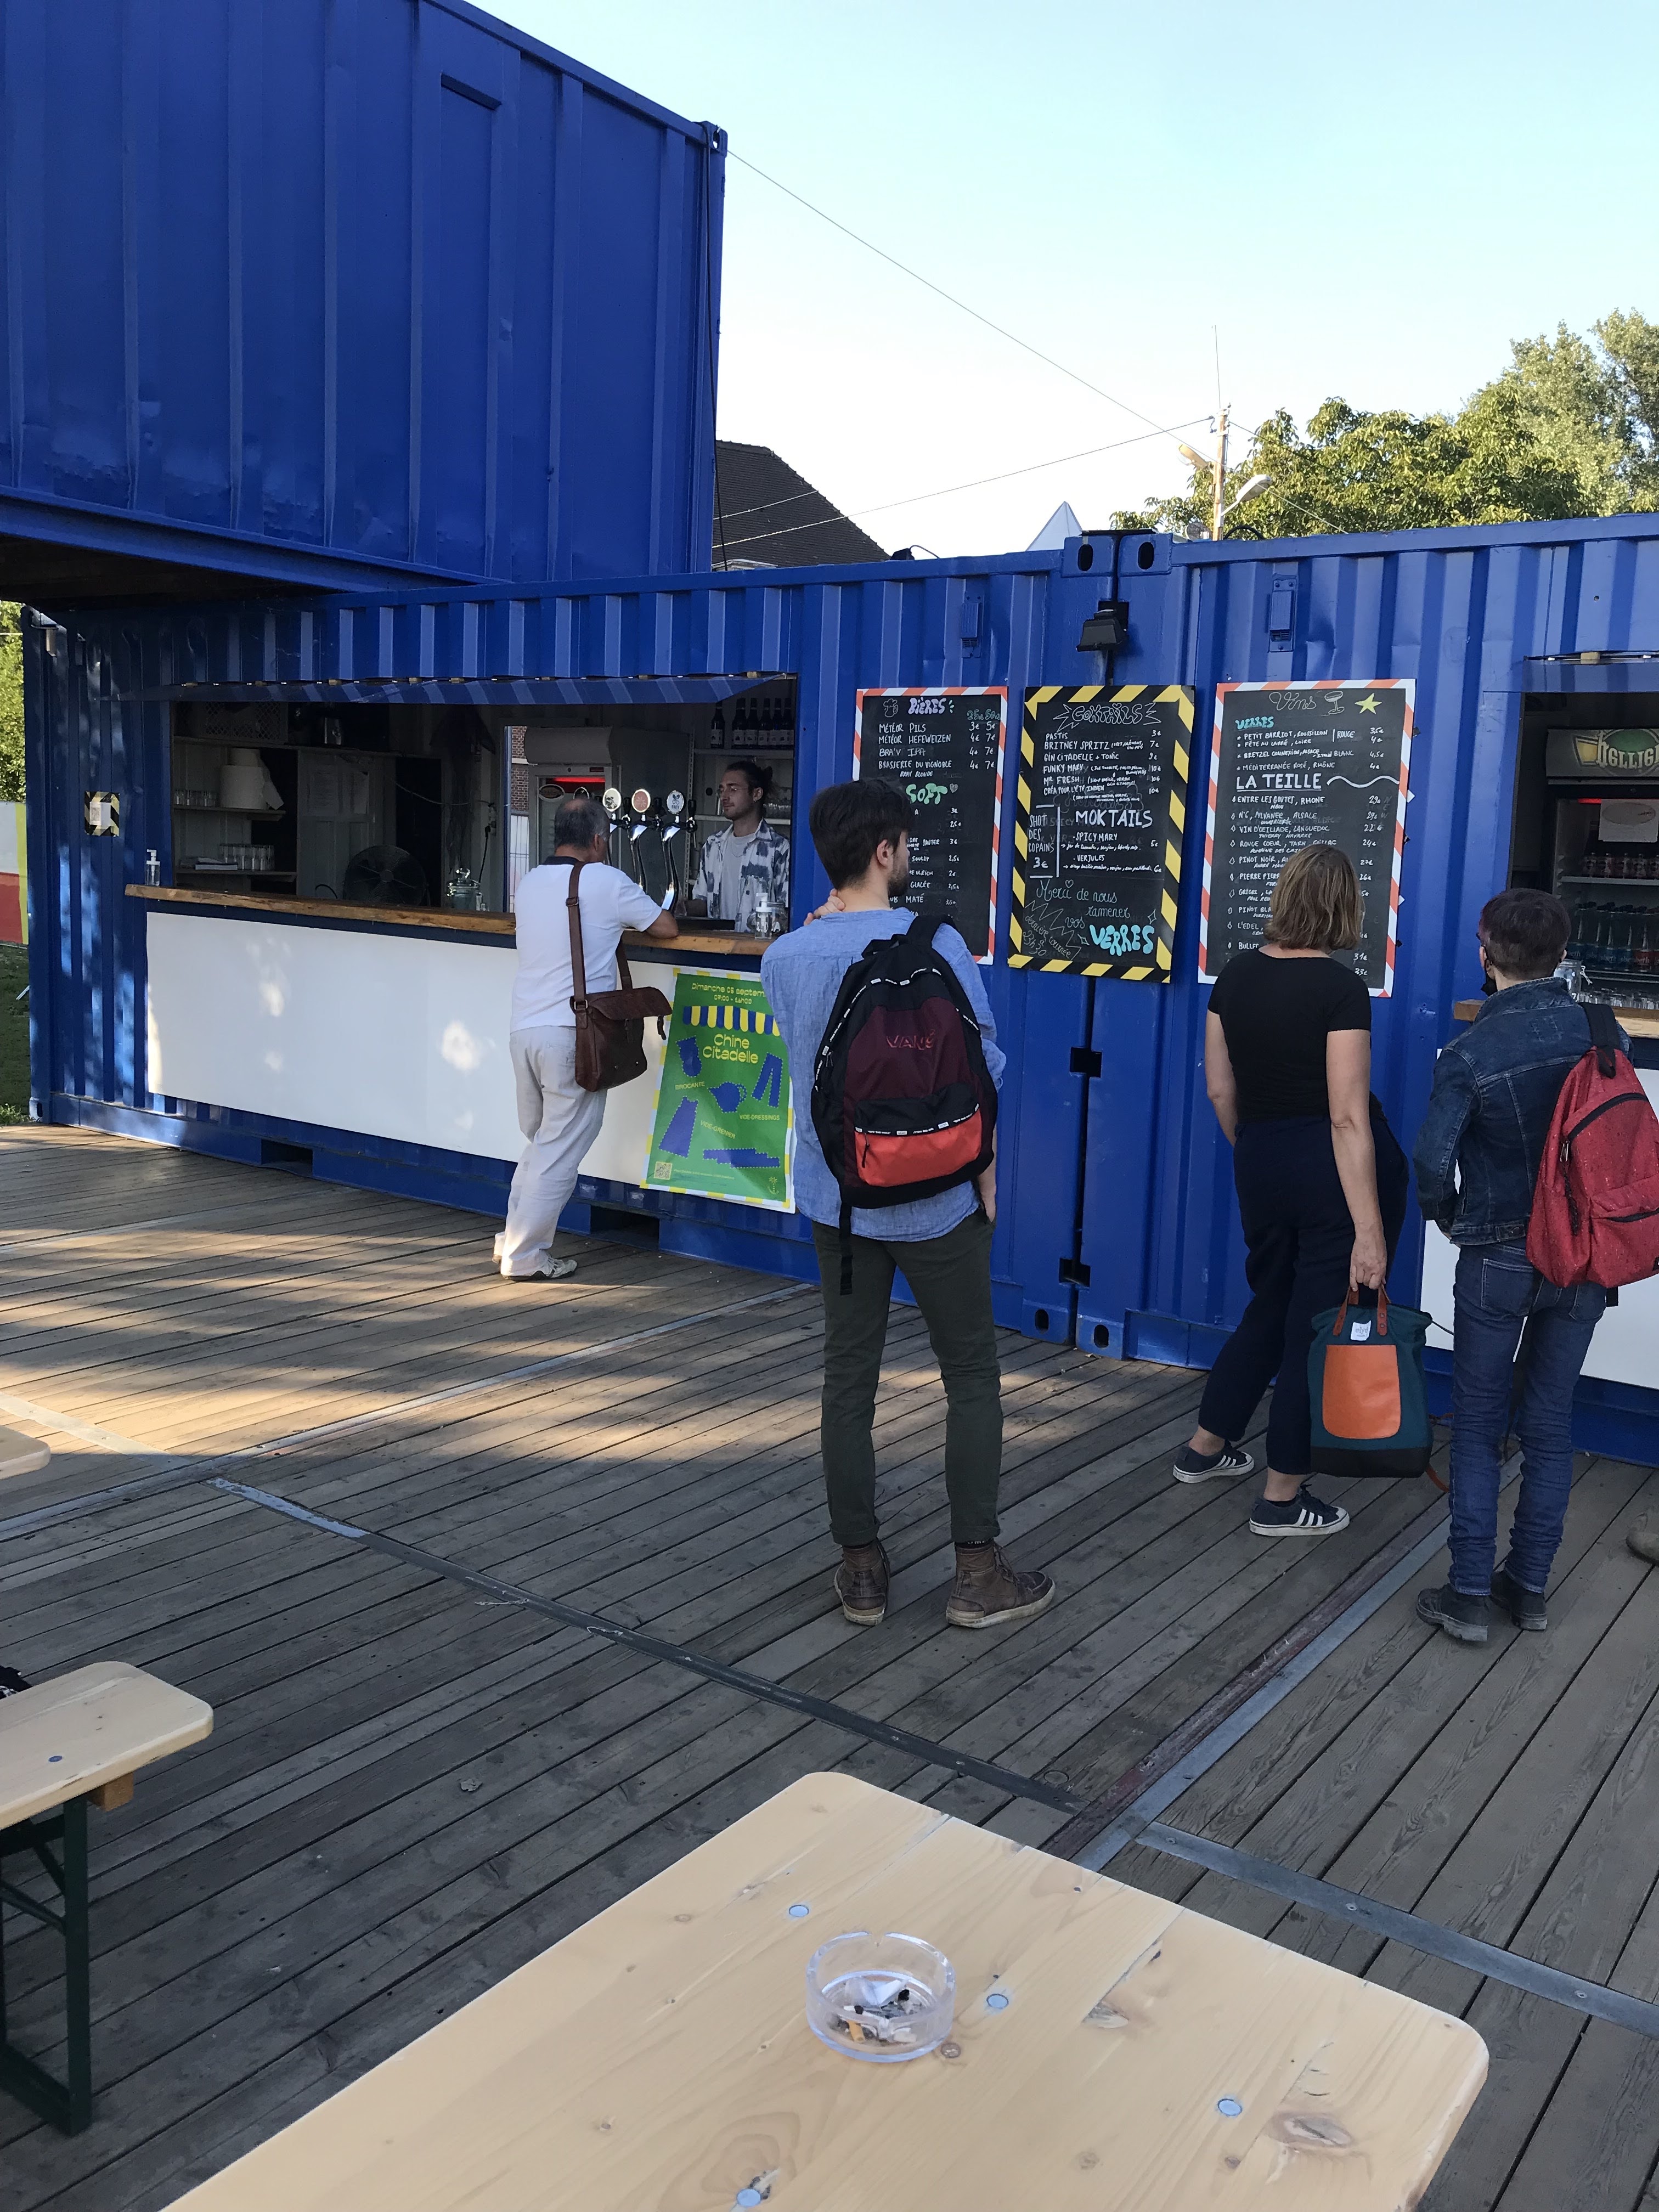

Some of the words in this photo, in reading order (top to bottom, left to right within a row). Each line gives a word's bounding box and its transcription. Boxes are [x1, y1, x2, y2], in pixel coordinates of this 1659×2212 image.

[1269, 692, 1317, 710] Vins
[910, 723, 926, 733] PILS
[1235, 716, 1274, 730] VERRES
[909, 734, 951, 744] HEFEWEIZEN
[1044, 741, 1077, 750] BRITNEY
[1080, 741, 1110, 750] SPRITZ
[907, 747, 926, 757] IPA
[878, 760, 912, 769] BRASSERIE
[1043, 764, 1065, 774] FUNKY
[1068, 764, 1084, 772] MARY
[1057, 776, 1080, 785] FRESH
[1236, 775, 1257, 789] LA
[1262, 773, 1322, 789] TEILLE
[906, 783, 947, 805] SOFT
[1261, 795, 1272, 804] LES
[1301, 797, 1325, 805] RHONE
[1030, 814, 1047, 827] SHOT
[1075, 809, 1153, 828] MOKTAILS
[1029, 828, 1041, 841] DES
[1076, 832, 1097, 842] SPICY
[1098, 833, 1118, 842] MARY
[1028, 843, 1054, 853] COPAINS
[1033, 857, 1048, 868] 3€
[1076, 888, 1089, 901] de
[1093, 891, 1118, 903] nous
[1065, 916, 1085, 929] vos
[1090, 924, 1155, 956] VERRES
[691, 983, 725, 993] Dimanche
[736, 988, 766, 997] septem
[714, 1034, 749, 1049] Chine
[702, 1046, 758, 1064] Citadelle
[675, 1081, 706, 1090] BROCANTE
[701, 1120, 736, 1139] VIDE-GRENIER
